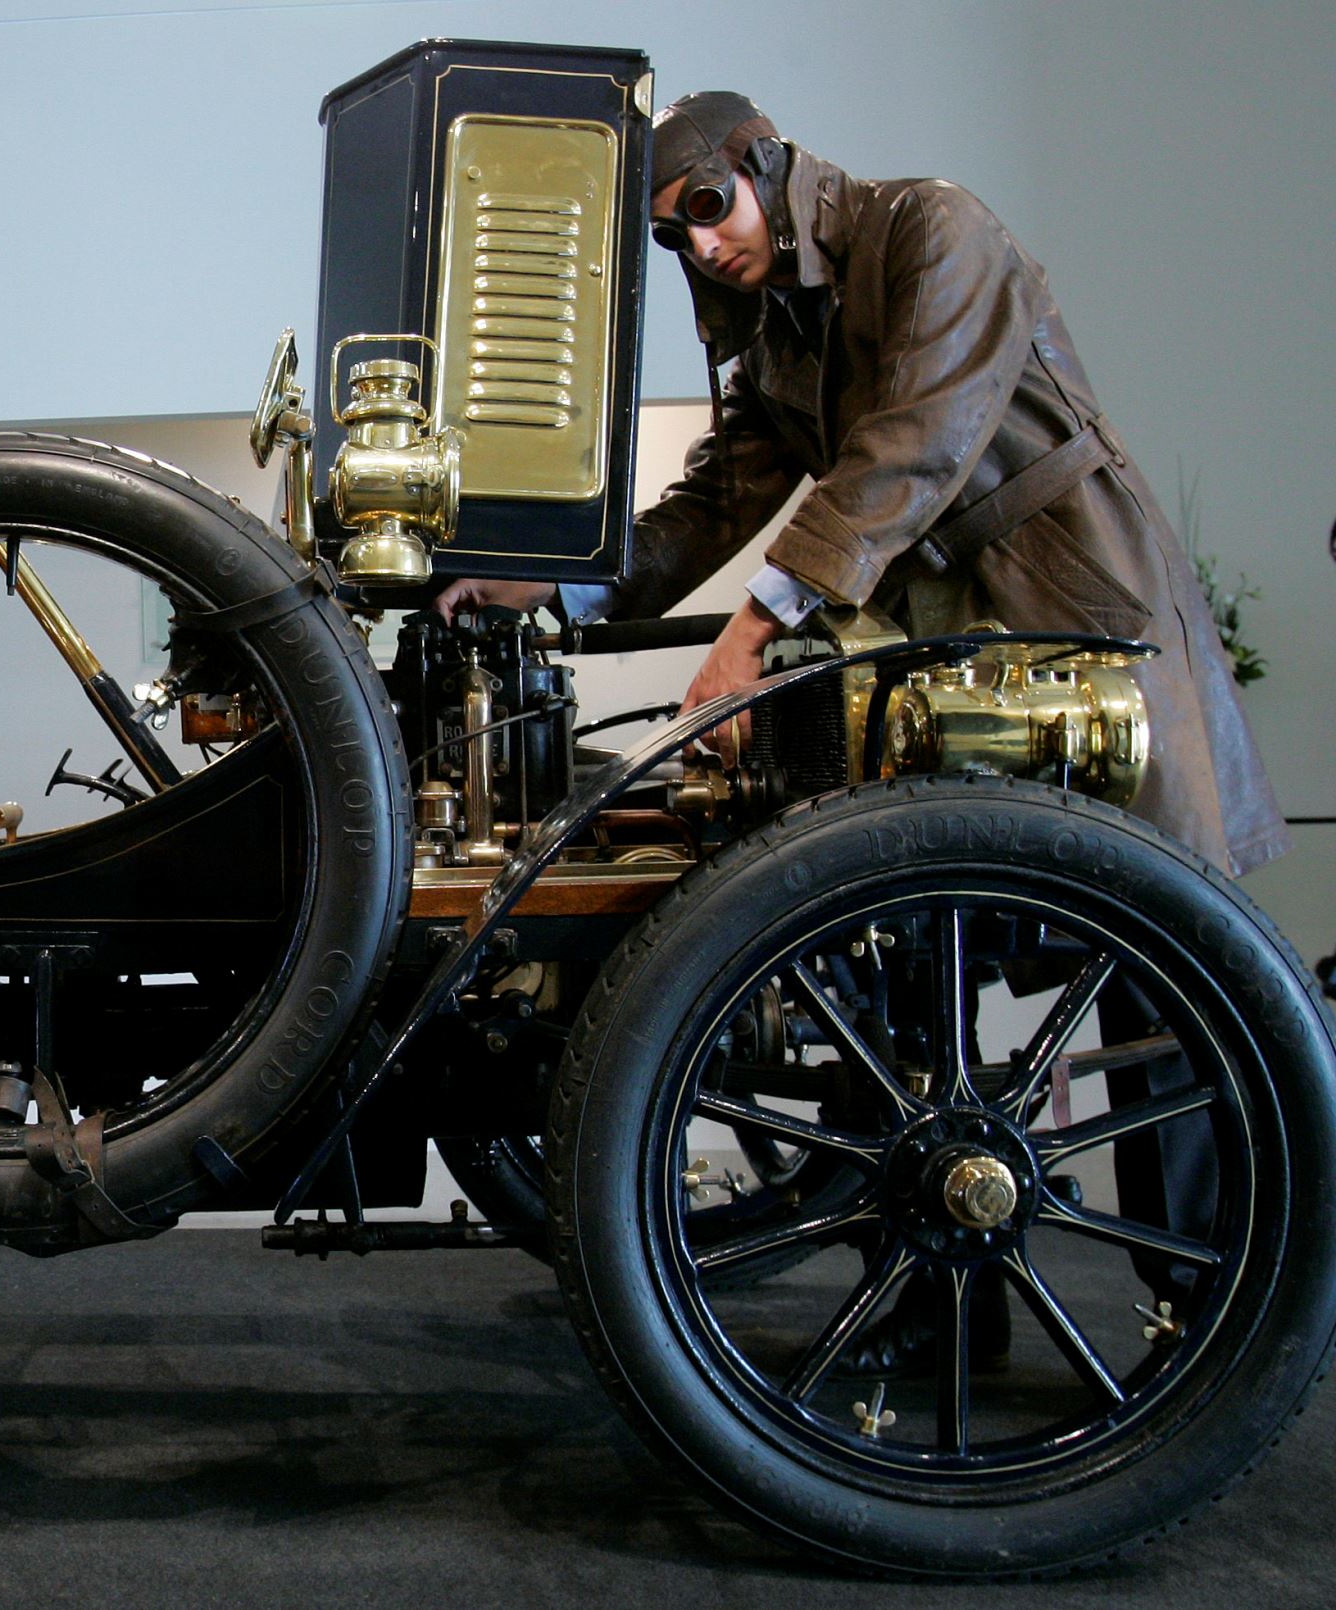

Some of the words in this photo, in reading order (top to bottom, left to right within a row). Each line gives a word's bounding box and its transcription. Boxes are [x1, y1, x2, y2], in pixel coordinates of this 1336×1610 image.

[269, 612, 376, 858] DUNLOP
[256, 950, 355, 1095] CORD
[864, 813, 1123, 873] DUNLOP
[1197, 909, 1309, 1046] CORD
